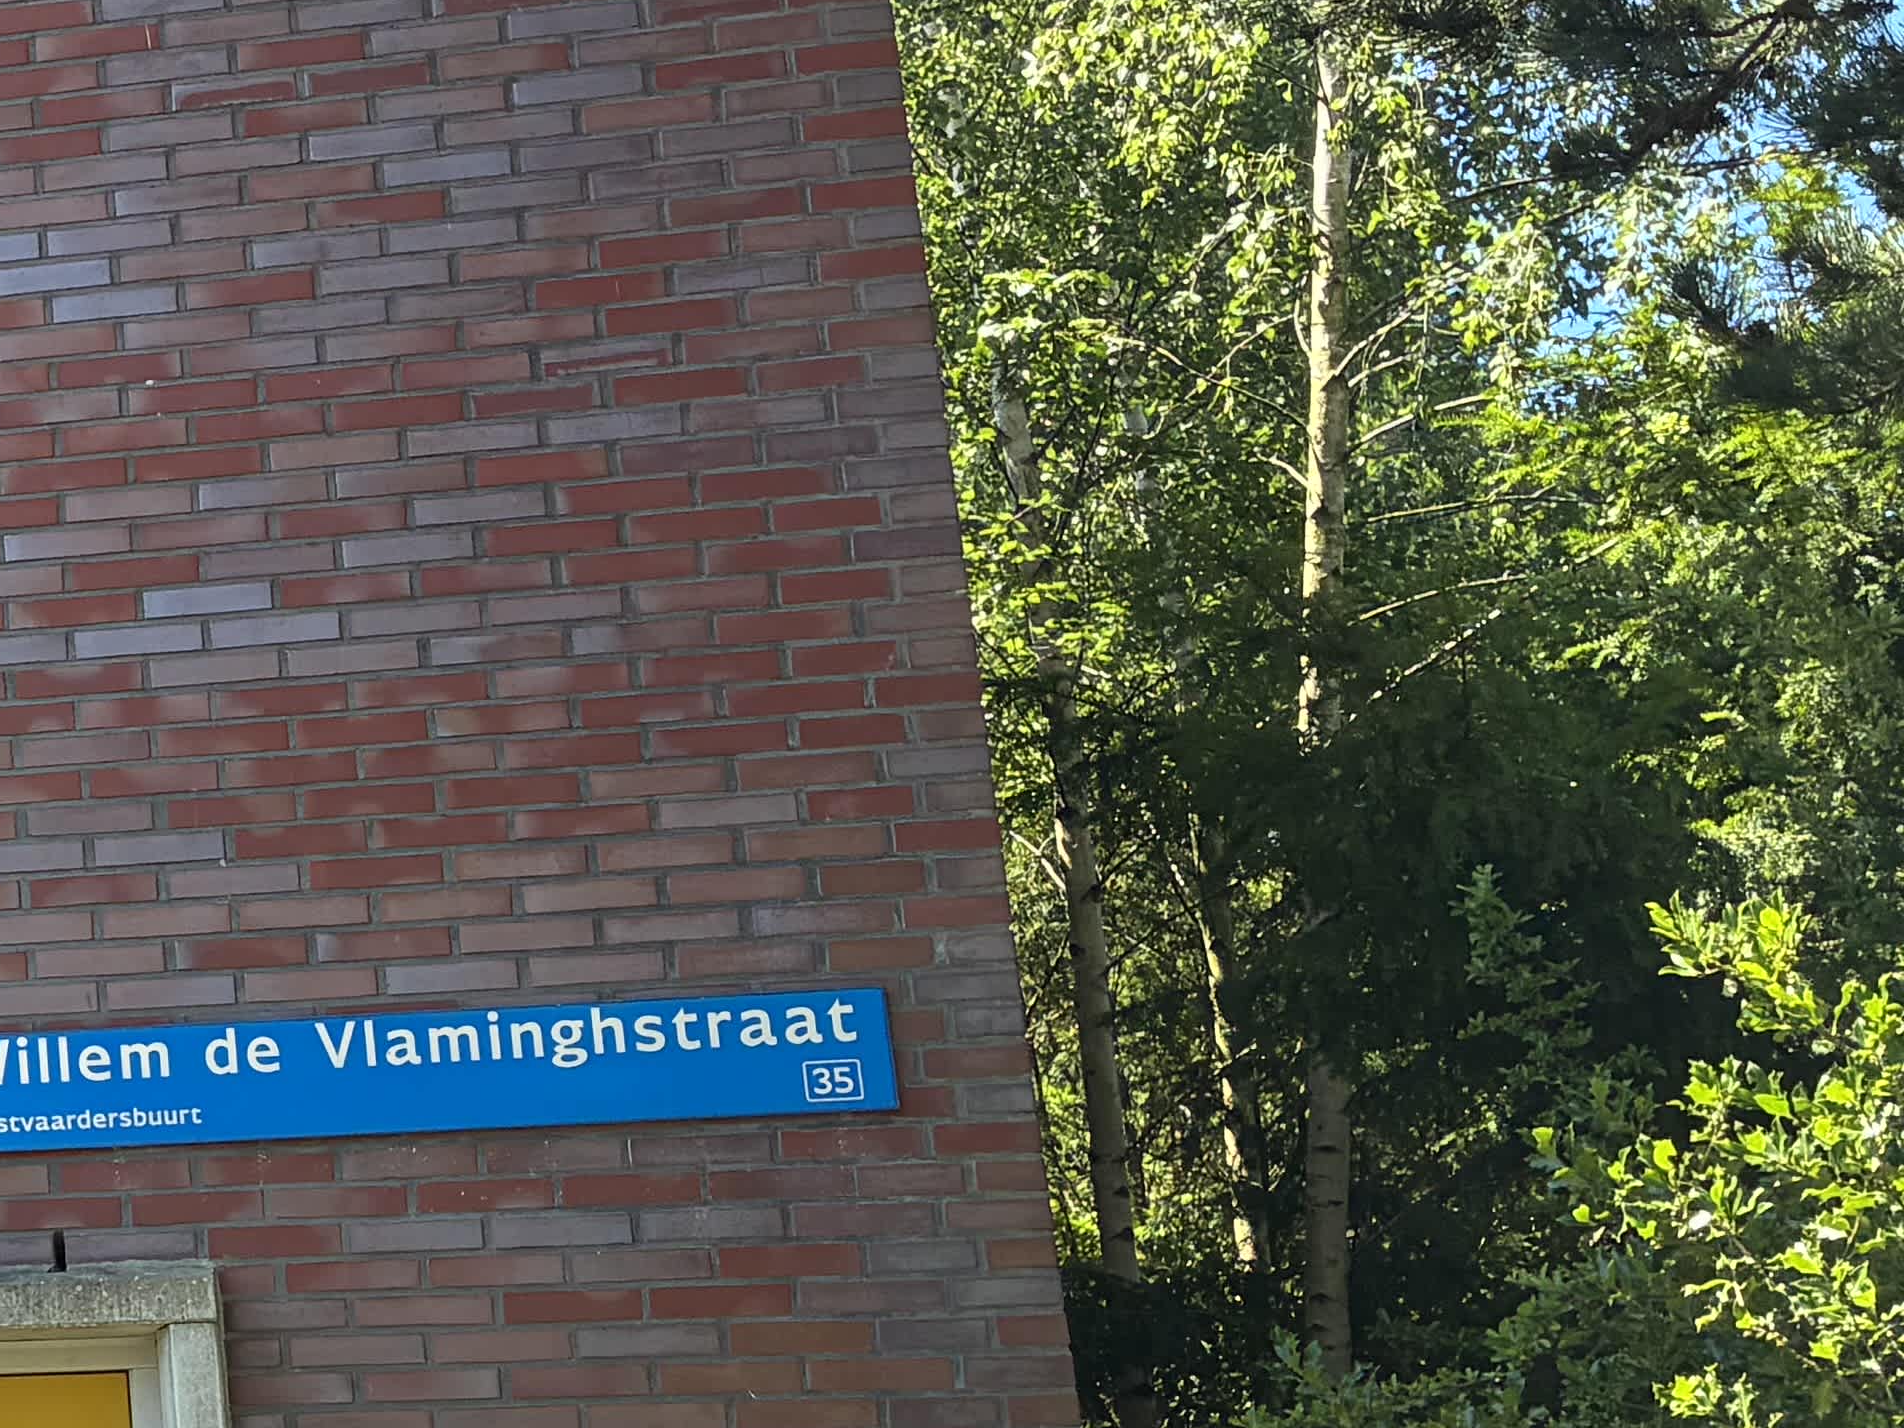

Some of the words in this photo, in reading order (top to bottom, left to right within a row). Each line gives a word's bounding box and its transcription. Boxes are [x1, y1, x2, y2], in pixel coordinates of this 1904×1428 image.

[205, 1028, 280, 1074] de
[314, 1000, 857, 1069] Vlaminghstraat
[812, 1067, 854, 1095] 35
